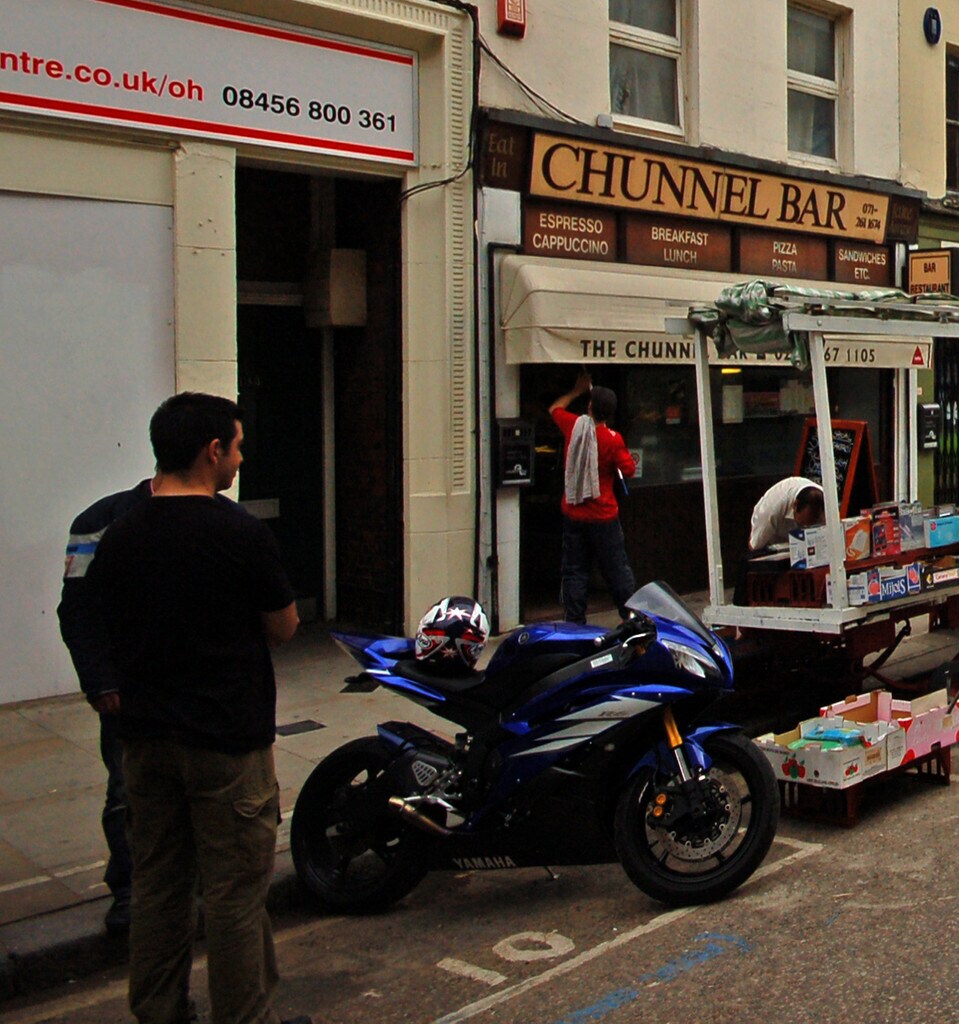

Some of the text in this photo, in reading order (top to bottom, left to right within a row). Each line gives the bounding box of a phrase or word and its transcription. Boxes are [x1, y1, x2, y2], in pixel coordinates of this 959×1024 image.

[222, 85, 301, 117] 08456
[308, 100, 351, 125] 800
[358, 109, 396, 133] 361
[488, 132, 515, 156] Eat
[490, 157, 508, 179] In
[541, 142, 770, 221] CHUNNEL
[776, 182, 848, 231] BAR
[539, 213, 603, 235] ESPRESSO
[532, 232, 609, 255] CAPPUCCINO
[651, 226, 709, 247] BREAKFAST
[663, 248, 698, 264] LUNCH
[773, 241, 798, 257] PIZZA
[838, 249, 887, 266] SANDWICHES
[771, 258, 797, 273] PASTA
[854, 266, 871, 280] ETC.
[923, 262, 937, 273] BAR
[910, 282, 950, 294] RESTAURANT
[580, 339, 617, 358] THE
[625, 340, 708, 360] CHUNN
[846, 347, 876, 363] 1105
[452, 855, 517, 870] YAMAHA
